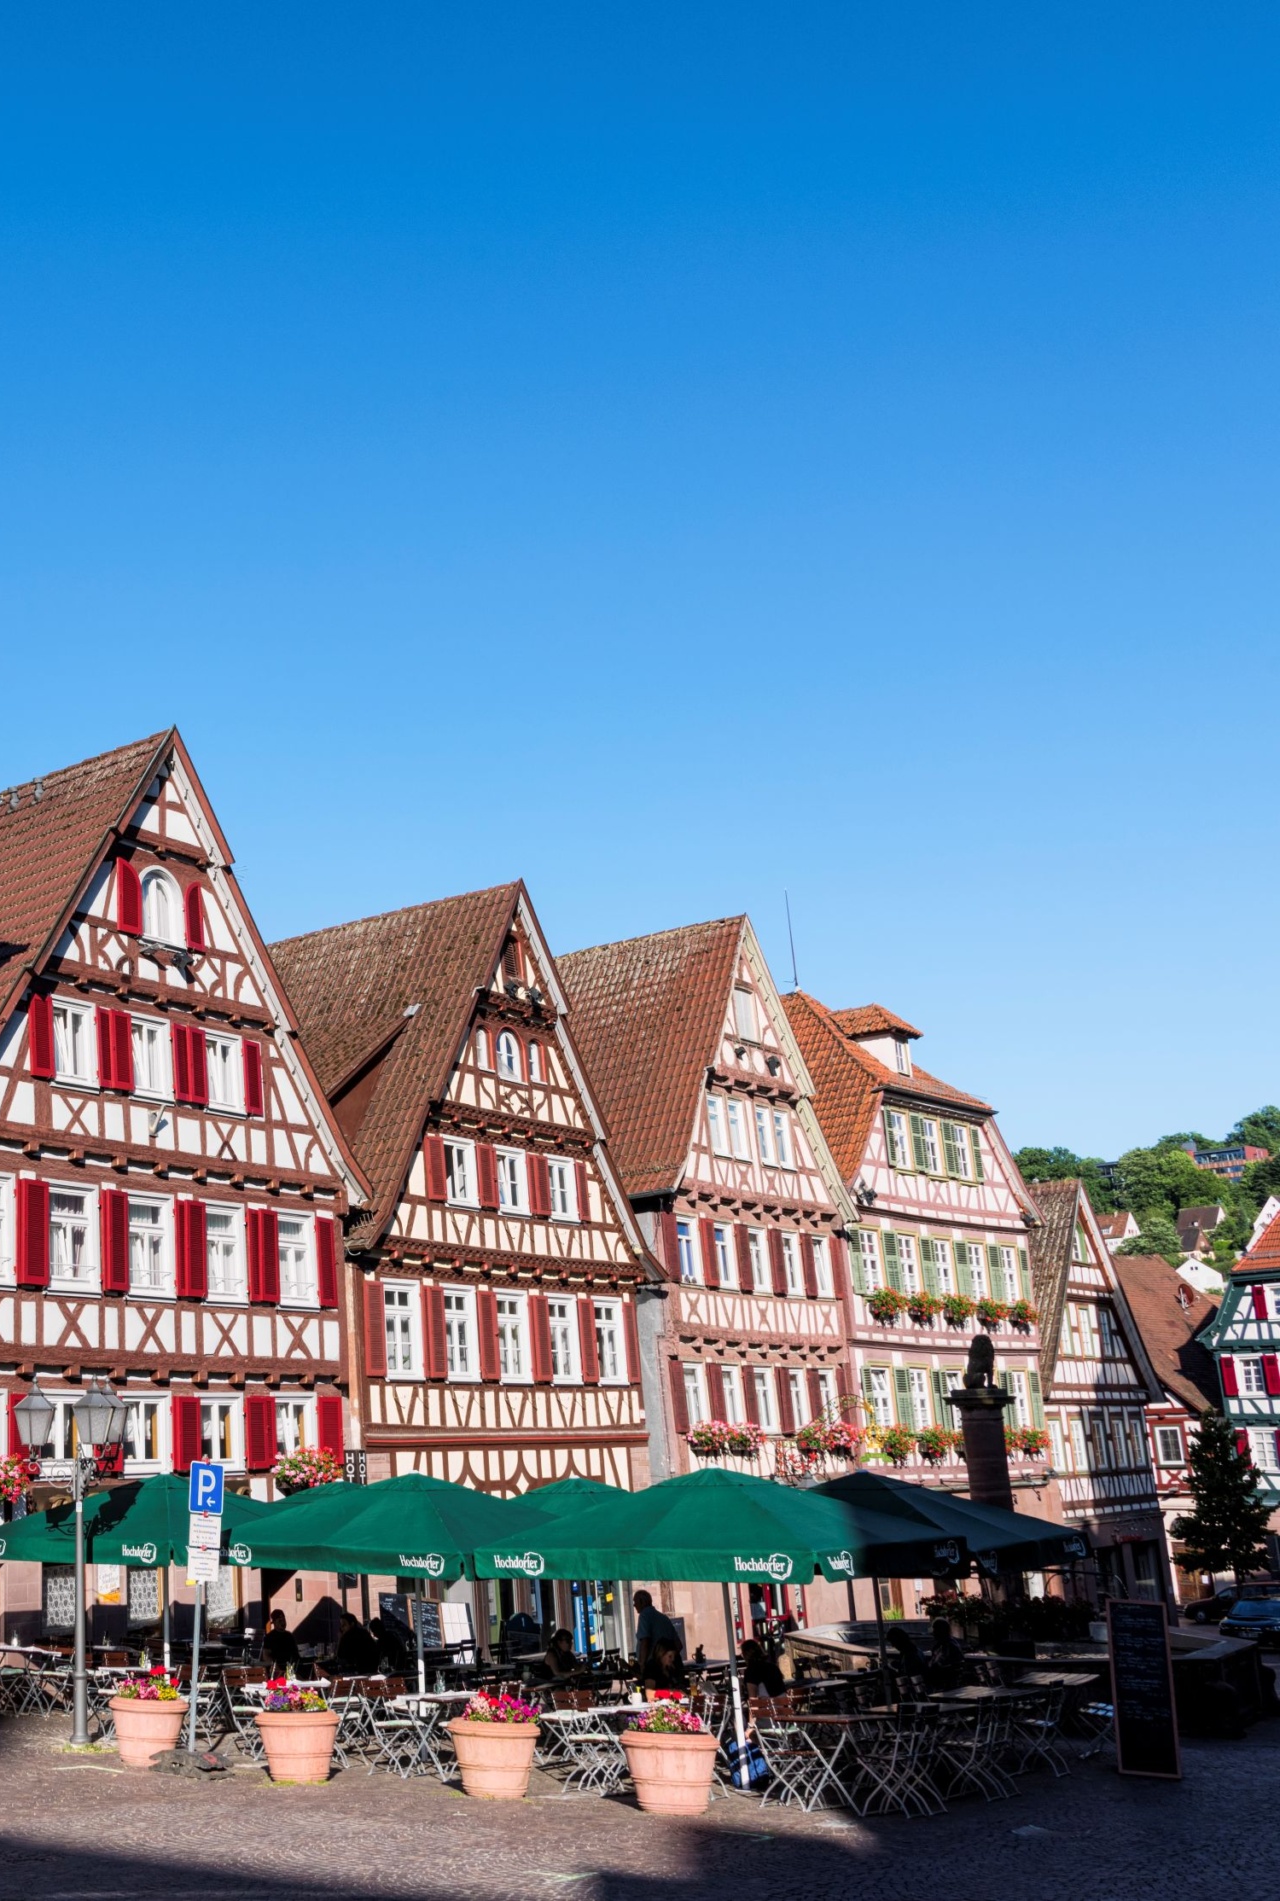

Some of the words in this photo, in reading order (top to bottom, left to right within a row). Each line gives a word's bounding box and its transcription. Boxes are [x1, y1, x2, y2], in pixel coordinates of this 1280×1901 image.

[197, 1469, 216, 1506] P
[399, 1554, 440, 1570] Hochdorfer
[494, 1555, 538, 1569] Hochdorfer
[733, 1556, 786, 1572] Hochdorfer
